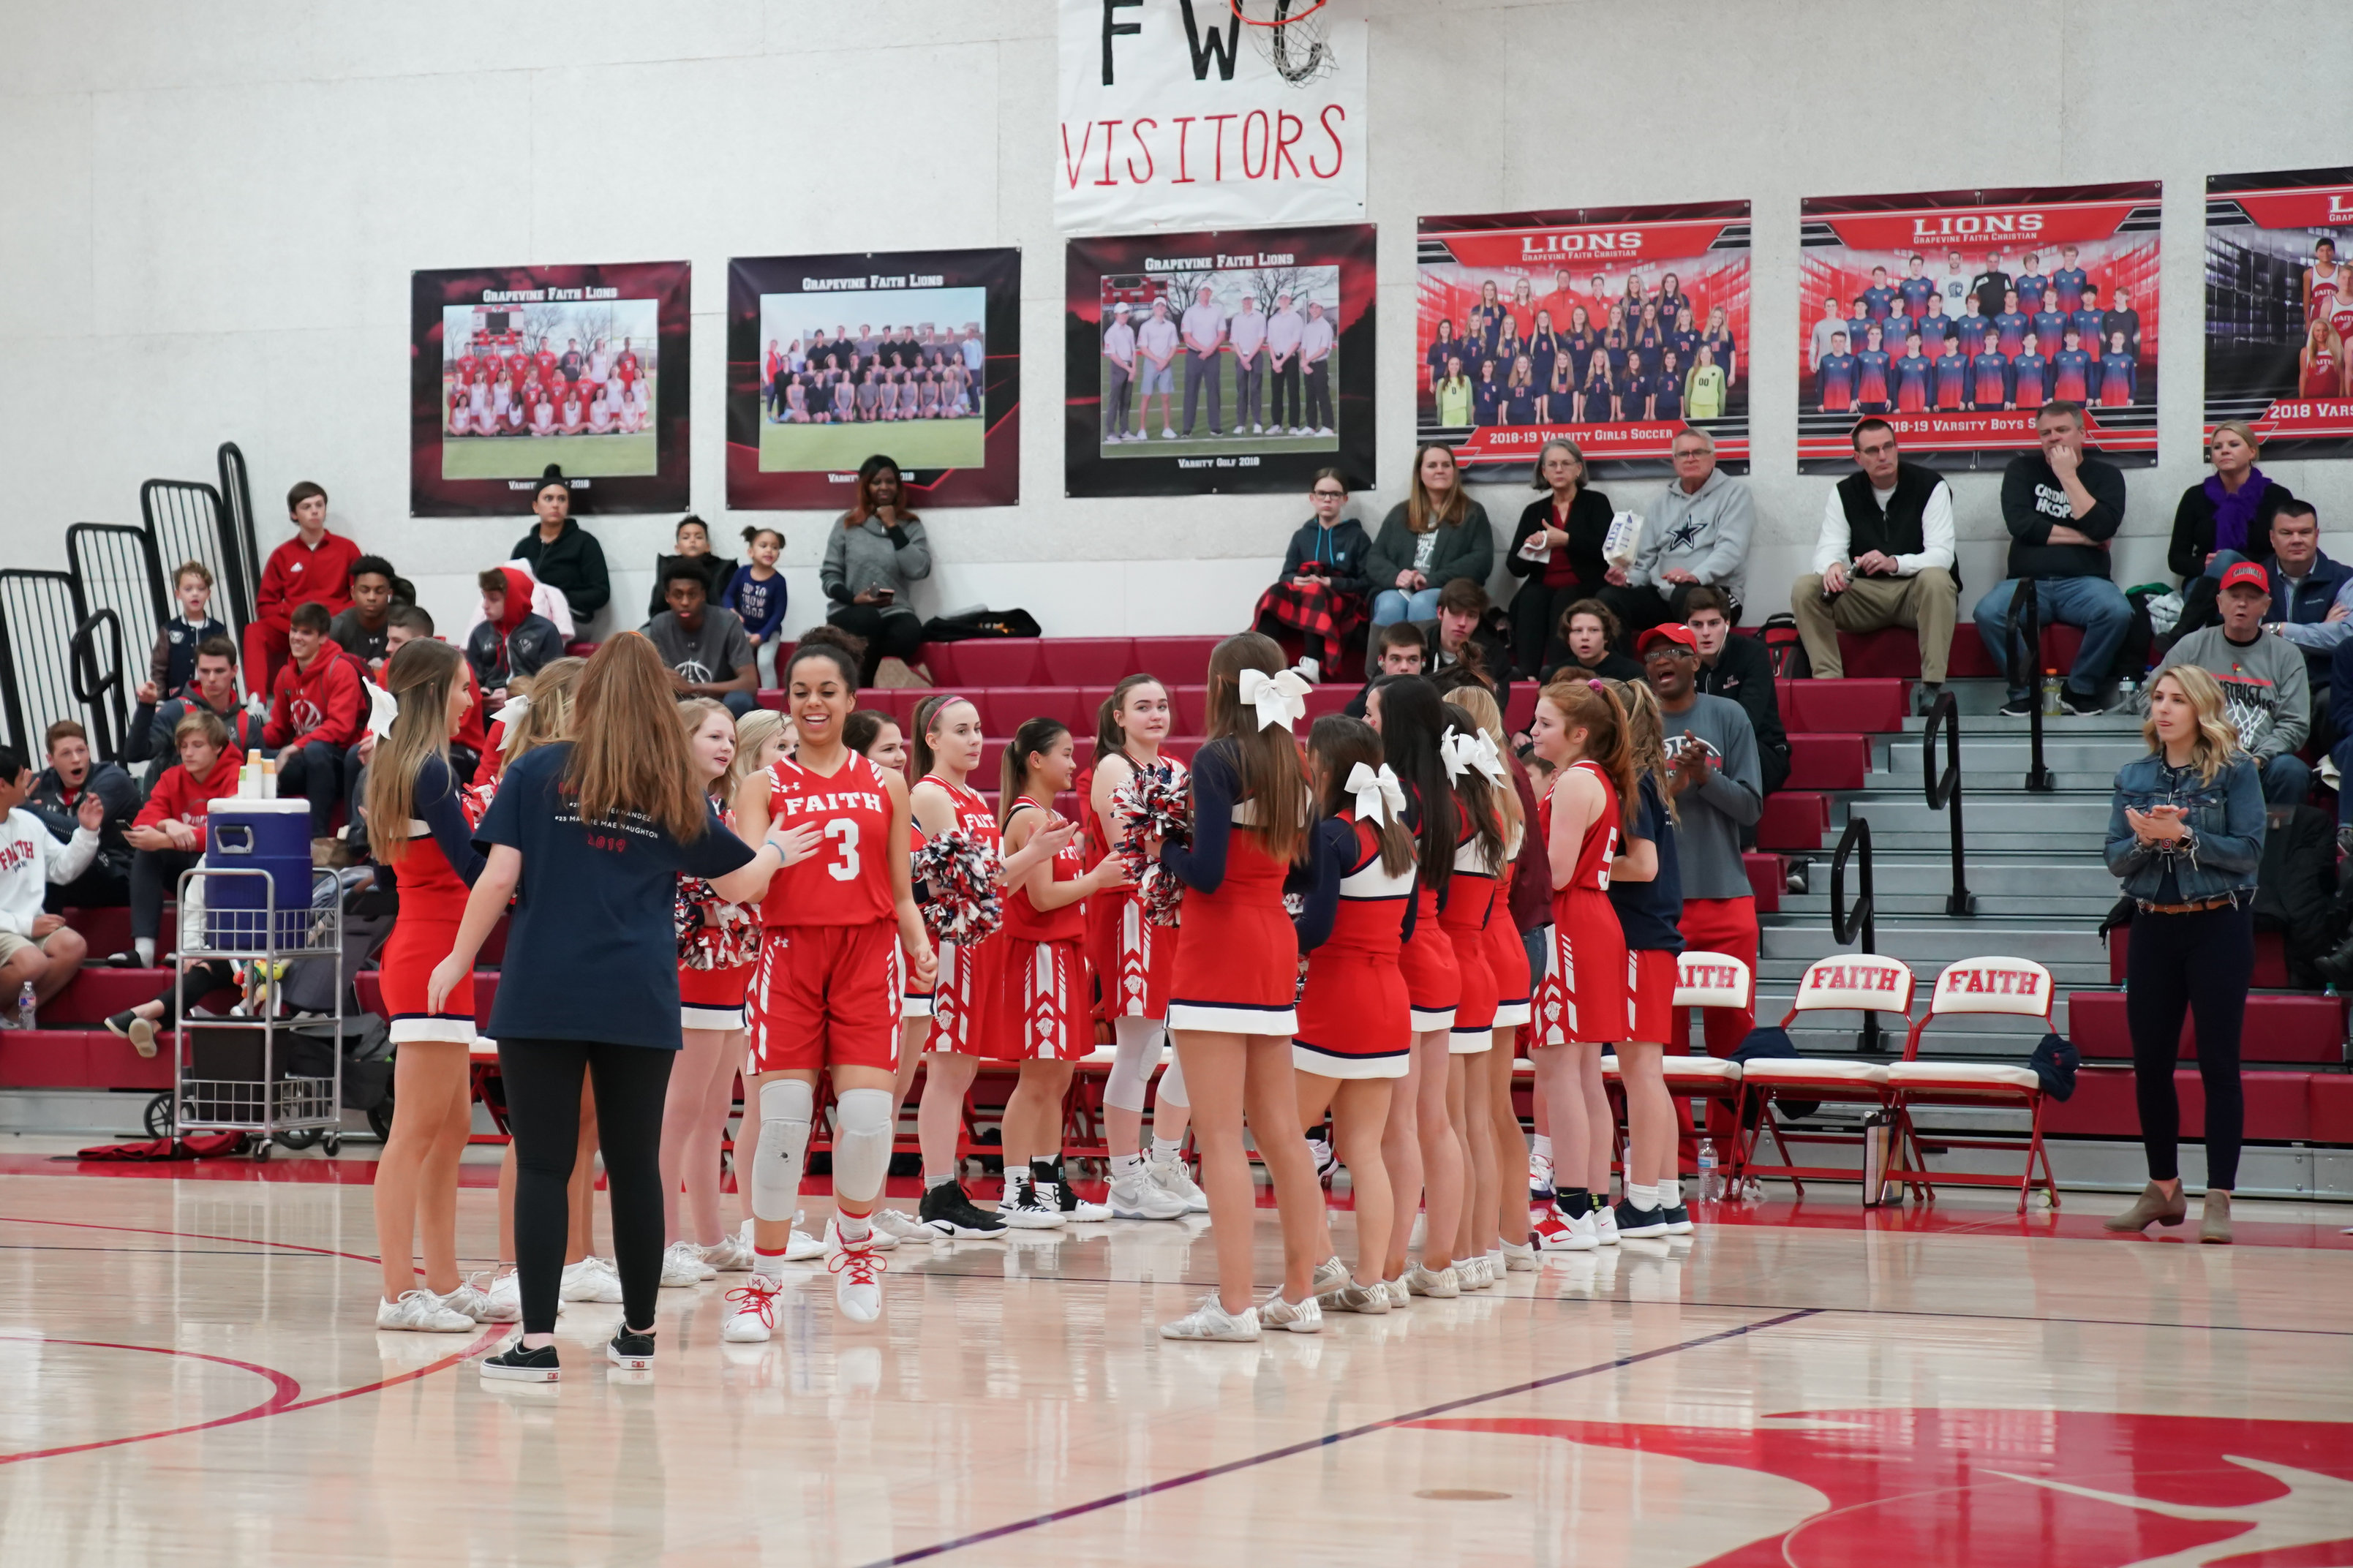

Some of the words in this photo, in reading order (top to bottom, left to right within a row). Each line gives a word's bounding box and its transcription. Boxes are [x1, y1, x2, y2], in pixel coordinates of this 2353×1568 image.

[1061, 104, 1345, 189] VISITORS
[1913, 214, 2043, 235] LIONS
[1522, 231, 1642, 253] LIONS
[1913, 235, 1959, 244] GRAPEVINE
[1963, 234, 1988, 242] FAITH
[1991, 233, 2037, 241] CHRISTIAN
[1145, 257, 1212, 271] GRAPEVINE
[1216, 255, 1254, 268] FAITH
[1258, 252, 1294, 265] LIONS
[802, 277, 866, 291] GRAPEVINE
[870, 275, 906, 288] FAITH
[909, 274, 944, 287] LIONS
[483, 290, 544, 302] GRAPEVINE
[548, 287, 581, 301] FAITH
[585, 286, 617, 299] LIONS
[2270, 404, 2311, 419] 2018
[1932, 420, 1987, 431] VARSITY
[1991, 418, 2024, 430] BOYS
[1490, 431, 1537, 444] 2018-19
[1595, 429, 1627, 441] GIRLS
[1631, 429, 1673, 440] SOCCER
[2036, 497, 2074, 519] HOOP
[784, 792, 882, 815] FAITH
[601, 821, 617, 829] MAE
[620, 823, 658, 839] NAUGHTON
[824, 818, 860, 881] 3
[1676, 965, 1739, 989] AITH
[1810, 965, 1902, 992] FAITH
[1946, 968, 2041, 995] FAITH
